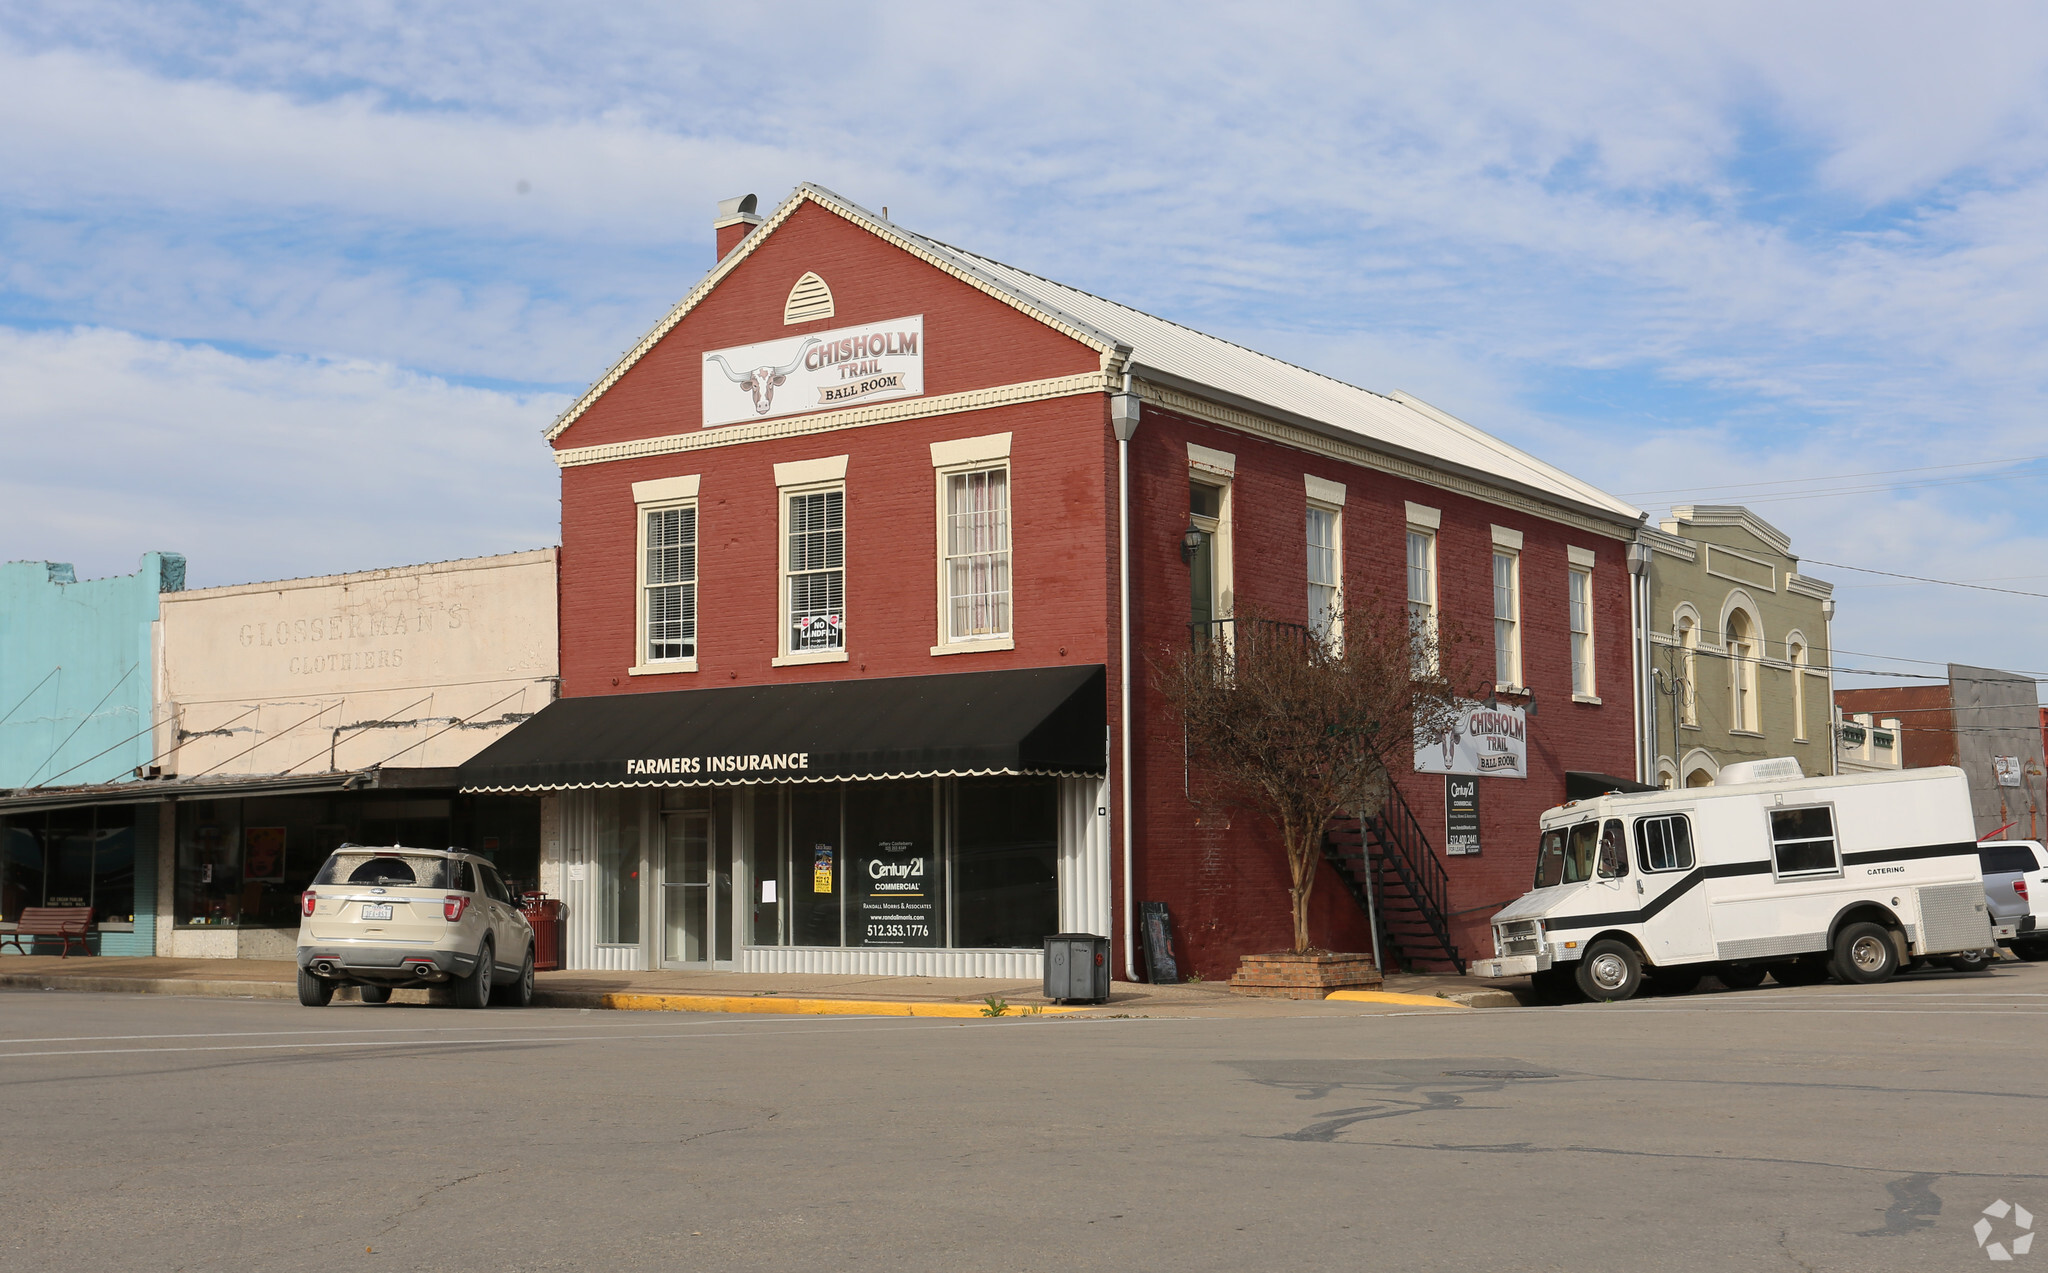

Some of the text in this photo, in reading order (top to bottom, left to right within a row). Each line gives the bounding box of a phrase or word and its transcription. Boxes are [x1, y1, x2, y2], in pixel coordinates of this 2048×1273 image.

[804, 331, 919, 372] CHISHOLM
[837, 359, 882, 380] TRAIL
[825, 375, 898, 401] BALL ROOM
[813, 621, 825, 630] NO
[289, 648, 403, 675] CLOTHIERS
[1469, 712, 1524, 743] CHISHOLM
[1486, 736, 1508, 751] TRAIL
[627, 753, 809, 774] FARMERS INSURANCE
[1481, 755, 1516, 768] BALL ROOM
[1867, 866, 1905, 876] CATERING
[875, 883, 919, 891] COMMERCIAL
[867, 924, 929, 937] 512.353.1776
